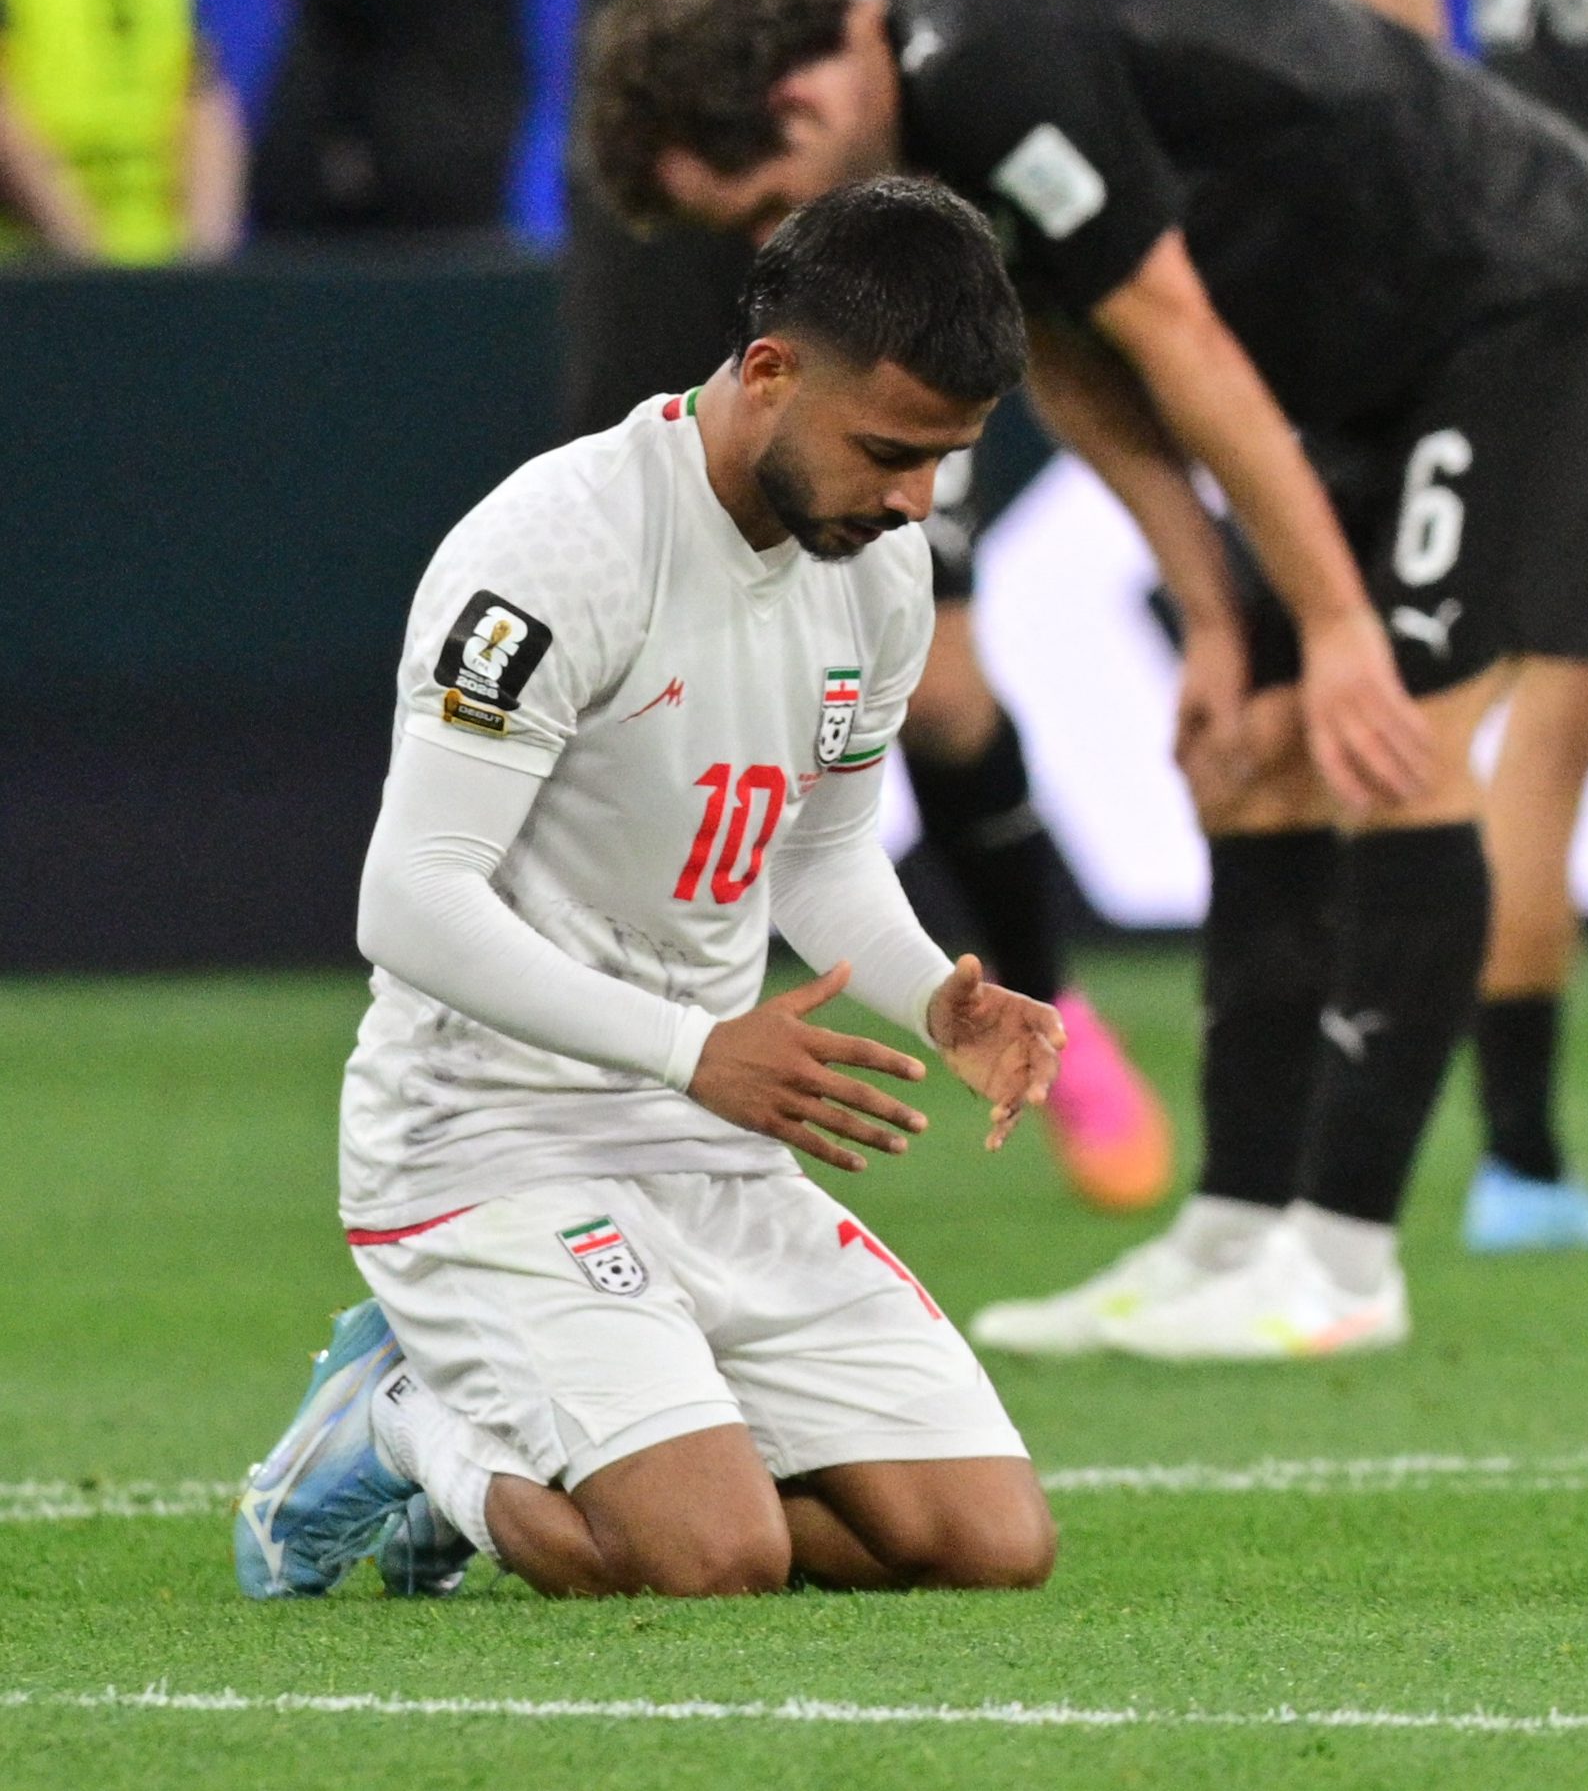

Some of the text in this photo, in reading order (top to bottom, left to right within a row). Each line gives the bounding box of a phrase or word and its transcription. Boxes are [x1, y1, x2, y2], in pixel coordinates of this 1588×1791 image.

[1394, 428, 1473, 586] 6
[455, 675, 499, 699] 2026
[458, 705, 503, 724] DEBUT
[673, 762, 787, 906] 10
